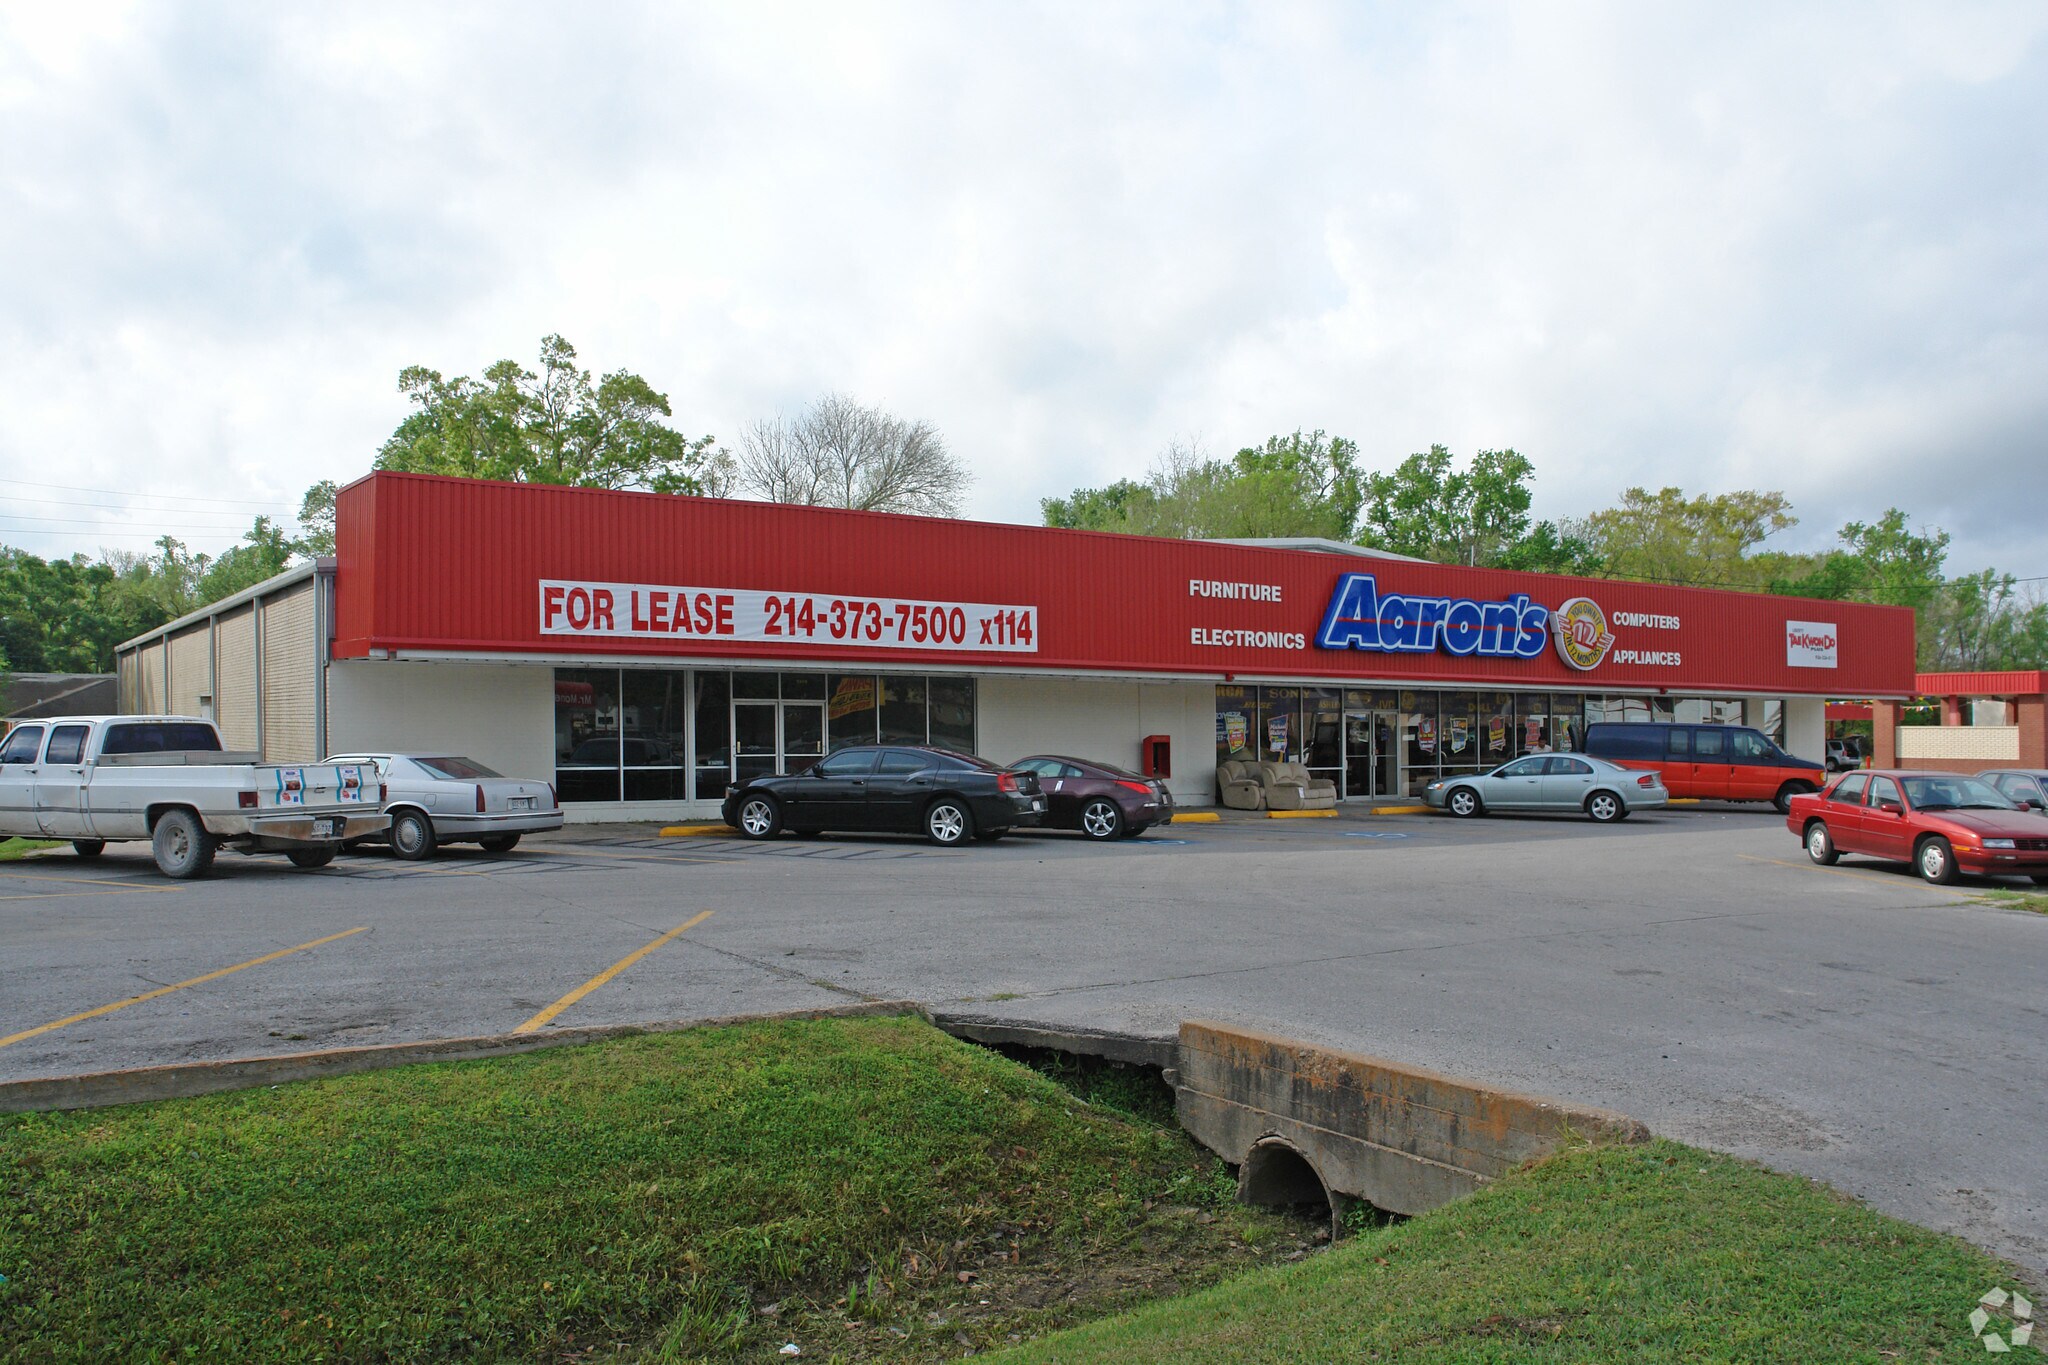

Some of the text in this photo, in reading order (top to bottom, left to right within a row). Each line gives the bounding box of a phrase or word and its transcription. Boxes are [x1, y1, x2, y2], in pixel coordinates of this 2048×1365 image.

[1190, 580, 1282, 602] FURNITURE
[544, 587, 1032, 646] FOR LEASE 214-373-7500 x114
[1325, 575, 1548, 657] Aaron's
[1571, 604, 1583, 617] YOU
[1583, 604, 1597, 620] OWN
[1613, 611, 1680, 630] COMPUTERS
[1191, 628, 1306, 649] ELECTRONICS
[1577, 648, 1601, 664] MONTHS
[1613, 649, 1681, 666] APPLIANCES
[1268, 689, 1311, 699] SONY
